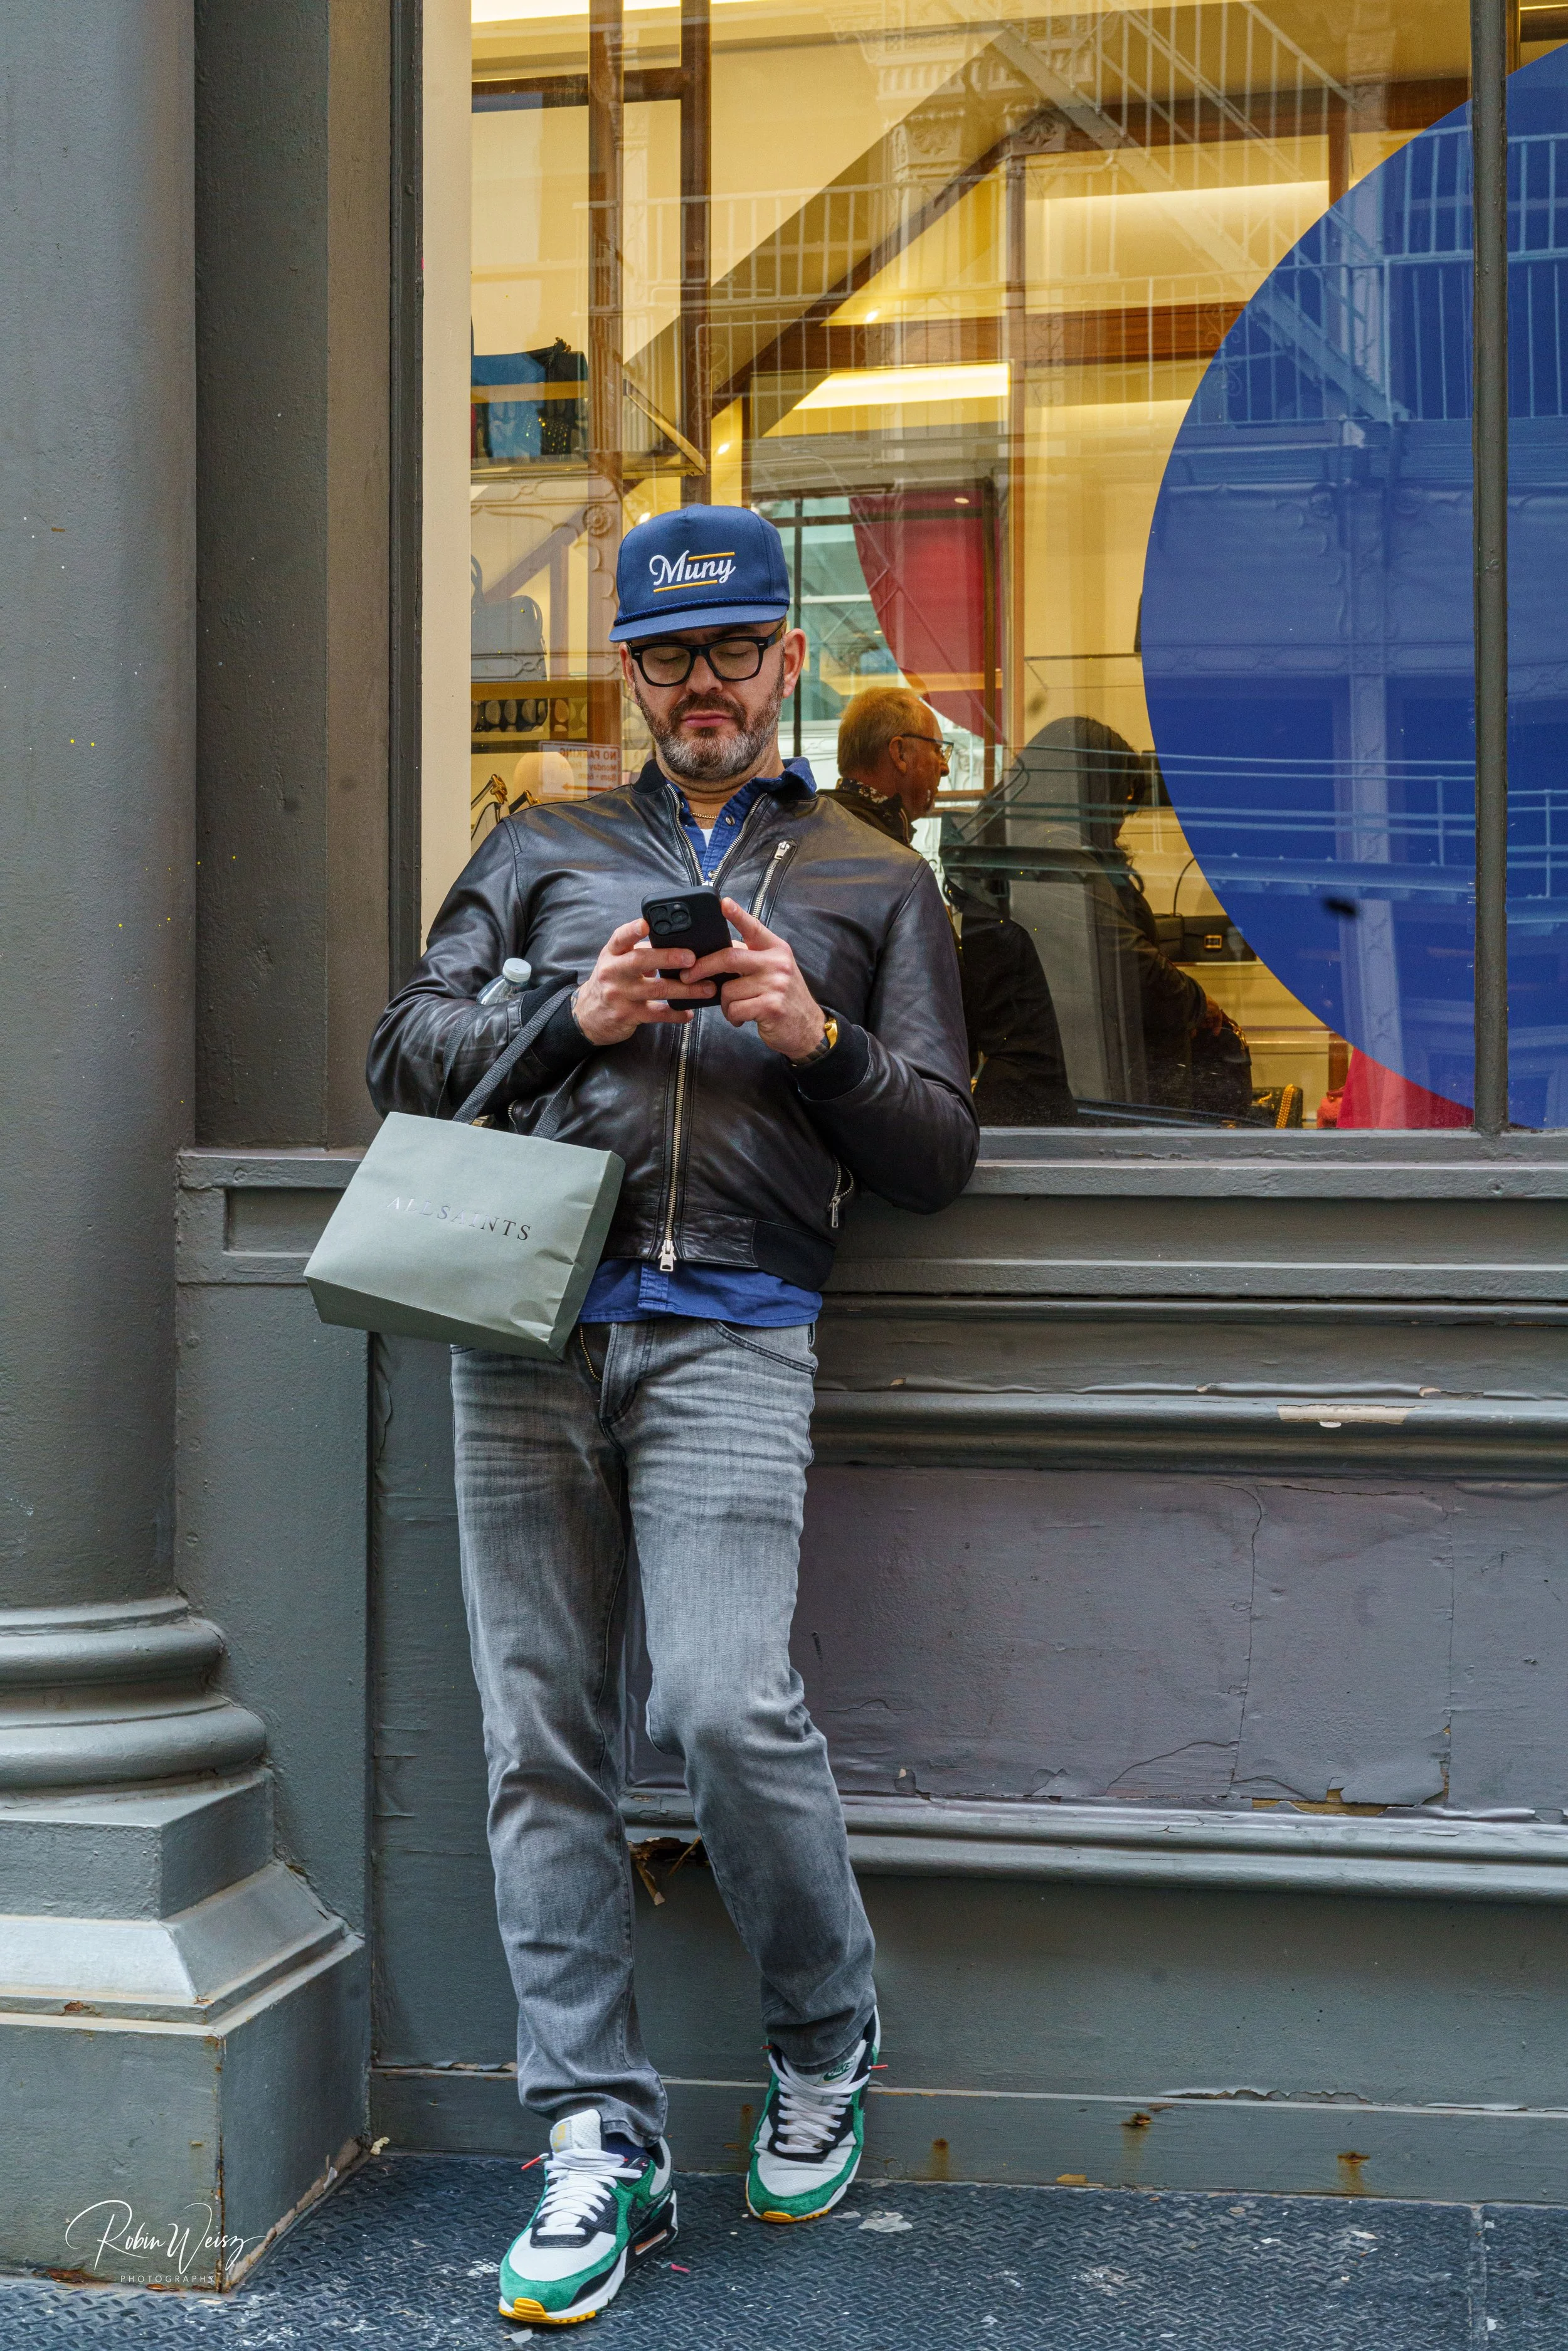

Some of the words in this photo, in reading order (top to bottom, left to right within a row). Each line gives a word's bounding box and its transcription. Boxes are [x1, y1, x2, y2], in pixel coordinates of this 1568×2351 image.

[649, 549, 736, 586] Muny
[386, 1196, 531, 1241] ALLSAINTS
[830, 2061, 851, 2073] NIKE
